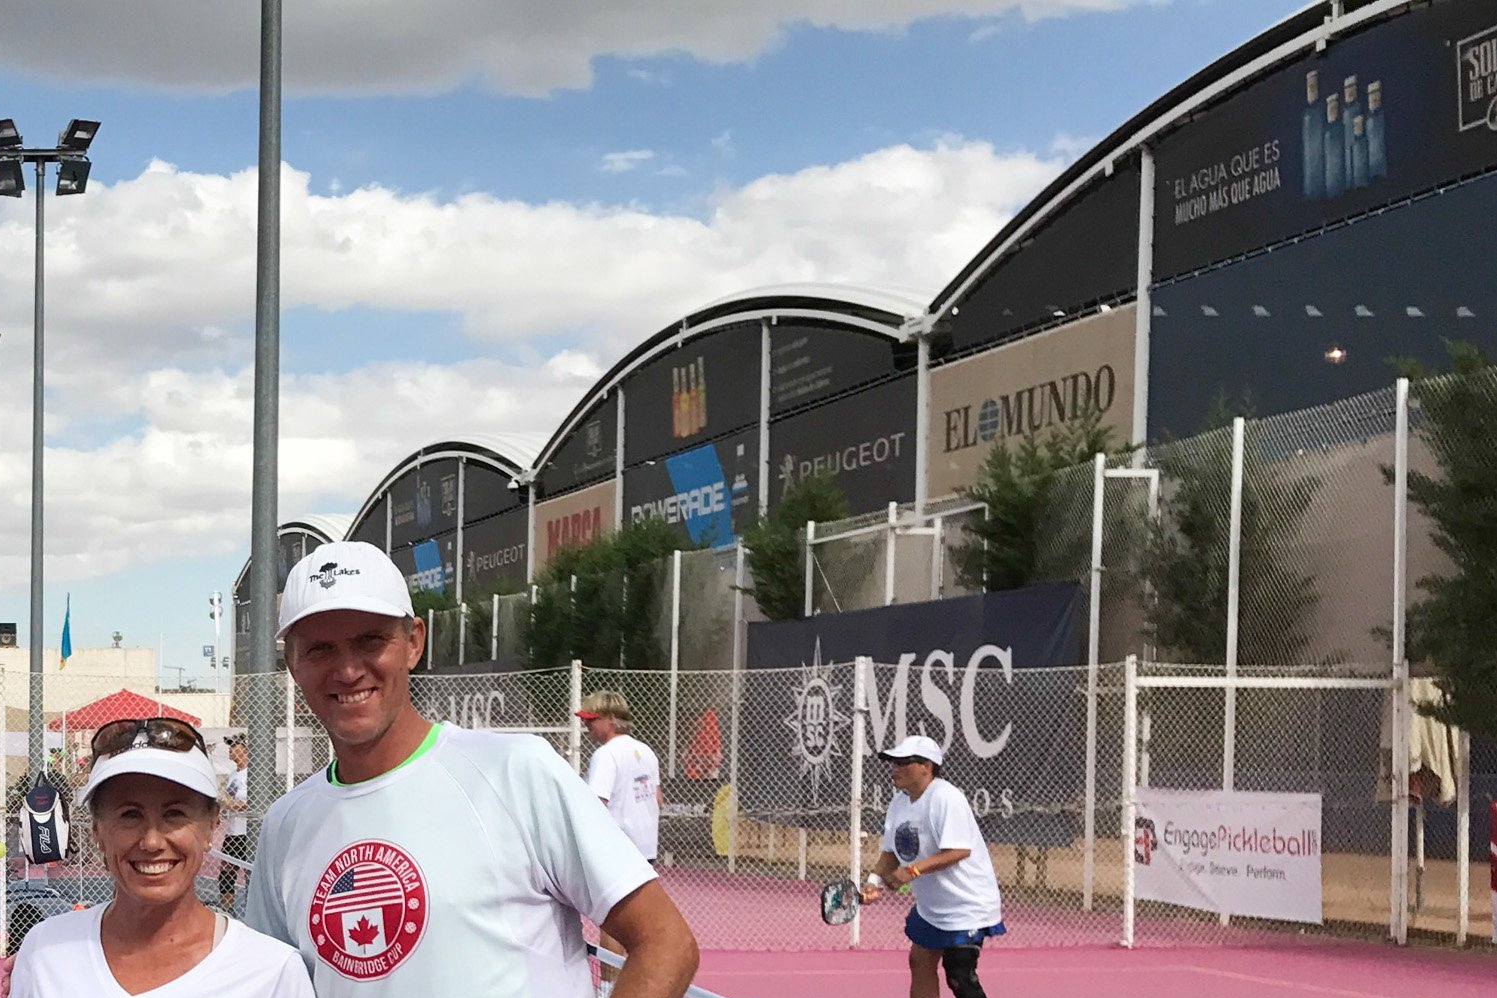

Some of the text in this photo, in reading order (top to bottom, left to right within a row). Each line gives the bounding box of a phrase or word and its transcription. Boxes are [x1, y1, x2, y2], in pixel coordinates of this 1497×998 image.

[1469, 38, 1497, 80] SO
[1175, 139, 1280, 199] EL AGUA QUE ES
[1175, 195, 1207, 226] MUCHO
[1230, 178, 1252, 204] QUE
[1252, 166, 1281, 196] AGUA
[943, 363, 1116, 453] EL MUNDO
[798, 432, 905, 481] PEUGEOT
[631, 481, 727, 526] POWERADE
[547, 506, 601, 558] MARCA
[476, 544, 526, 573] PEUGEOT
[855, 643, 1013, 759] MSC
[37, 825, 52, 854] FILA
[313, 845, 421, 906] TEAM NORTH AMERICA
[332, 942, 403, 975] BAINBRIDGE CUP
